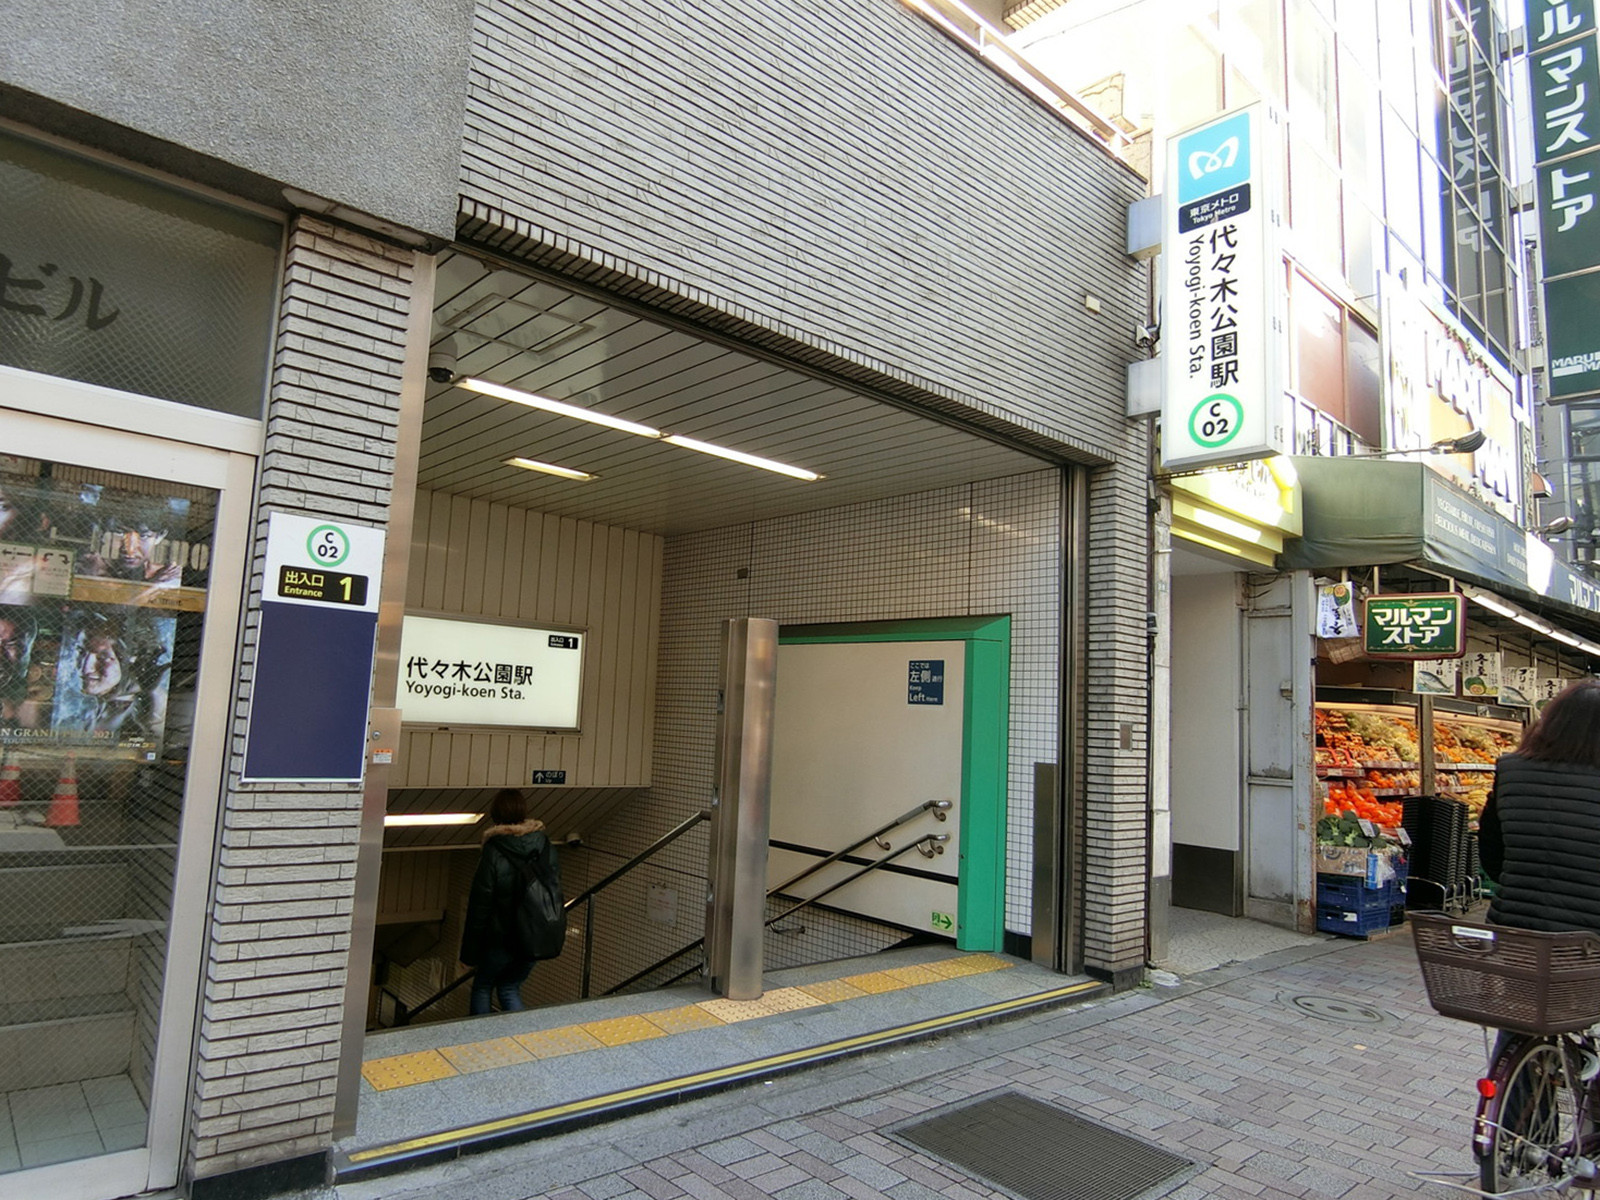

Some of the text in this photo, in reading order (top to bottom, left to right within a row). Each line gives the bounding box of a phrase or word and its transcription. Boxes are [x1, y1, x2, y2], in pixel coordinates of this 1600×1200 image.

[1537, 0, 1593, 232] ルマンストア
[1189, 193, 1239, 218] 東京メトロ
[1192, 204, 1237, 225] Tokyo Metro
[1185, 233, 1206, 379] Yoyogi-koen Sta.
[1209, 224, 1239, 389] 代々木公園駅
[1210, 402, 1221, 418] C
[1202, 418, 1229, 437] 02
[325, 532, 335, 543] C
[317, 544, 338, 558] 02
[284, 585, 323, 598] Entrance
[285, 570, 352, 601] 出入口 1
[1371, 607, 1453, 626] マルマン
[568, 638, 573, 648] 1
[1381, 626, 1441, 644] ストア
[406, 656, 533, 686] 代々木公園駅
[405, 680, 526, 700] Yoyogi-koen Sta.
[910, 693, 925, 702] Left
